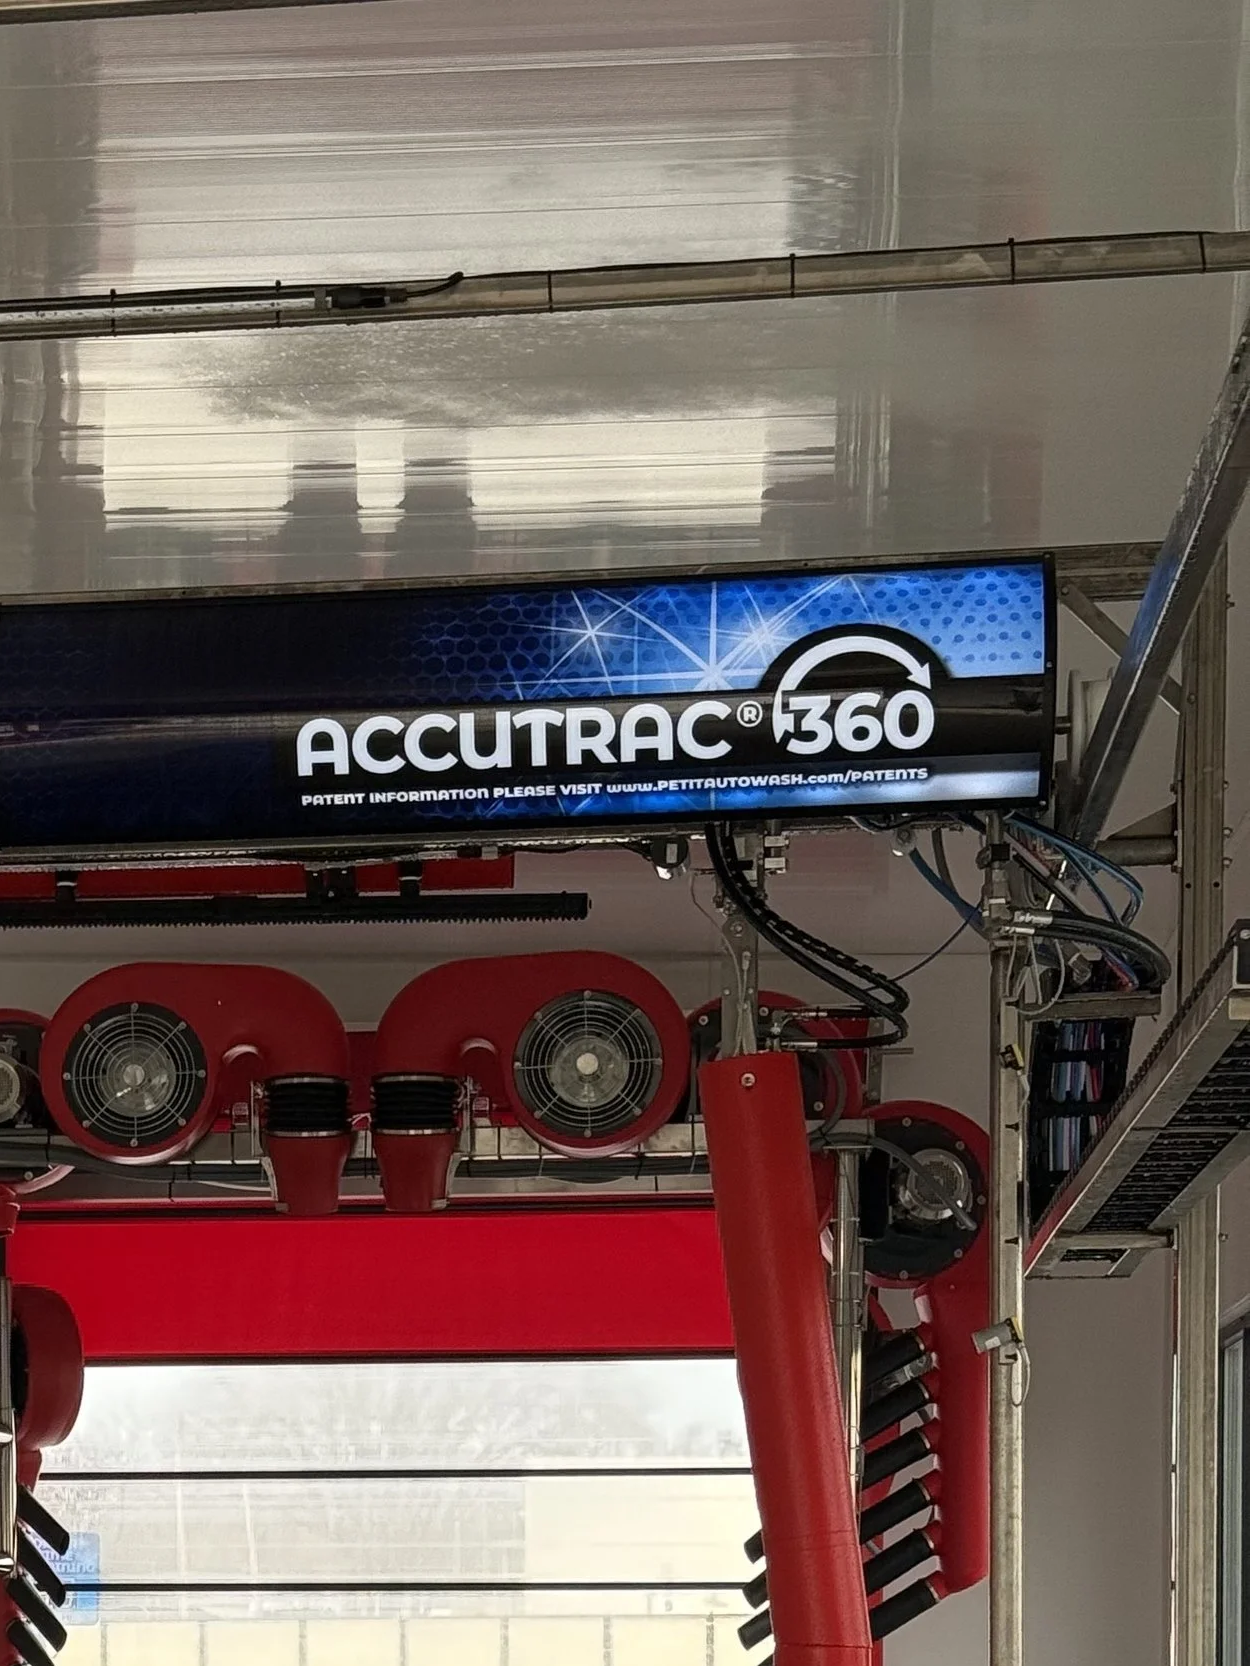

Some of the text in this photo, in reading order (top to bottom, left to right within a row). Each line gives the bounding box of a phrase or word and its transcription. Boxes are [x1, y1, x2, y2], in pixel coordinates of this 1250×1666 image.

[785, 689, 935, 755] 360
[301, 792, 366, 807] PATENT
[369, 787, 490, 804] INFORMATION
[493, 784, 556, 799] PLEASE
[560, 782, 603, 796] VISIT
